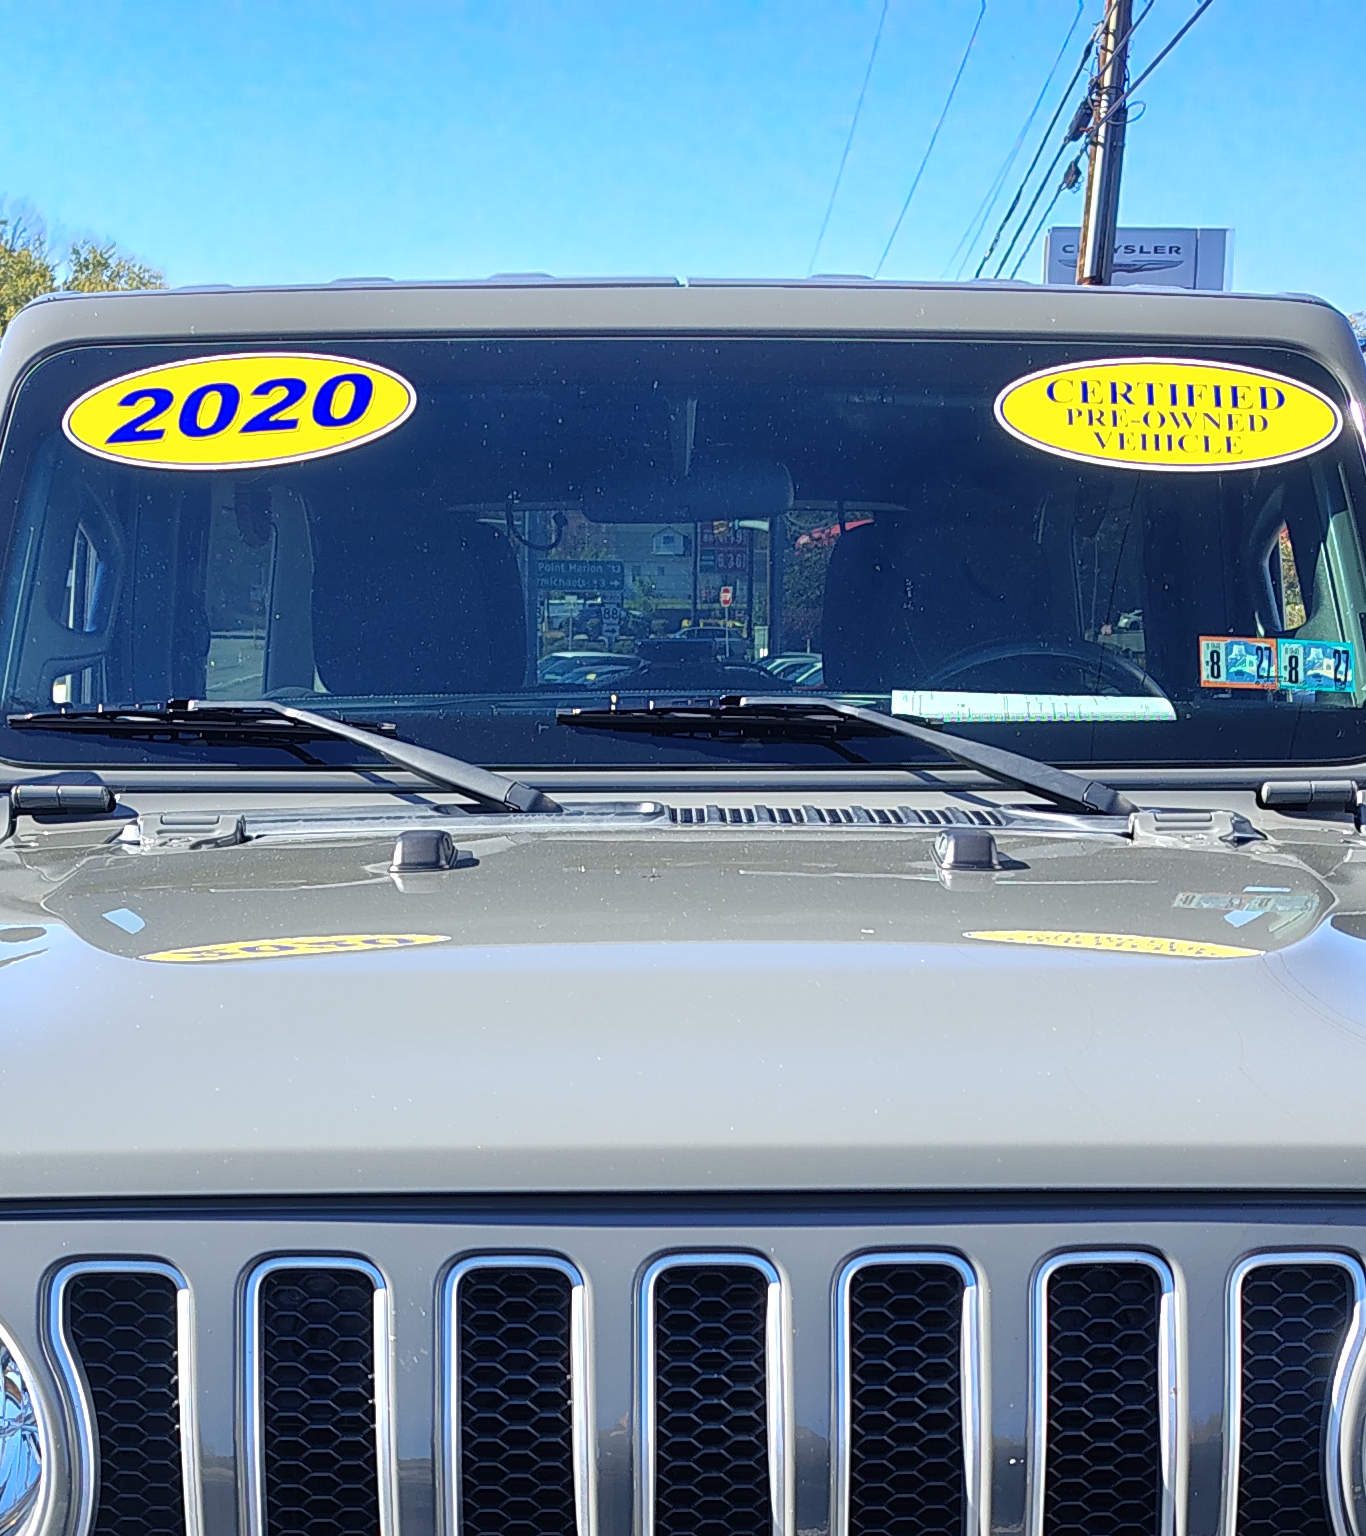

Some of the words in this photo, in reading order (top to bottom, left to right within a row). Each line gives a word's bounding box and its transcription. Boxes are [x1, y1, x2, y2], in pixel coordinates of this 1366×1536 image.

[1061, 244, 1182, 256] CYSLER
[1045, 378, 1286, 411] CERTIFIED
[105, 372, 374, 445] 2020
[1066, 407, 1269, 433] PRE-OWNED
[1093, 431, 1244, 456] VEHICLE
[537, 562, 566, 573] Point
[568, 562, 603, 573] Marion
[603, 607, 618, 619] 88
[1209, 650, 1222, 679] 8
[1287, 655, 1300, 684] 8
